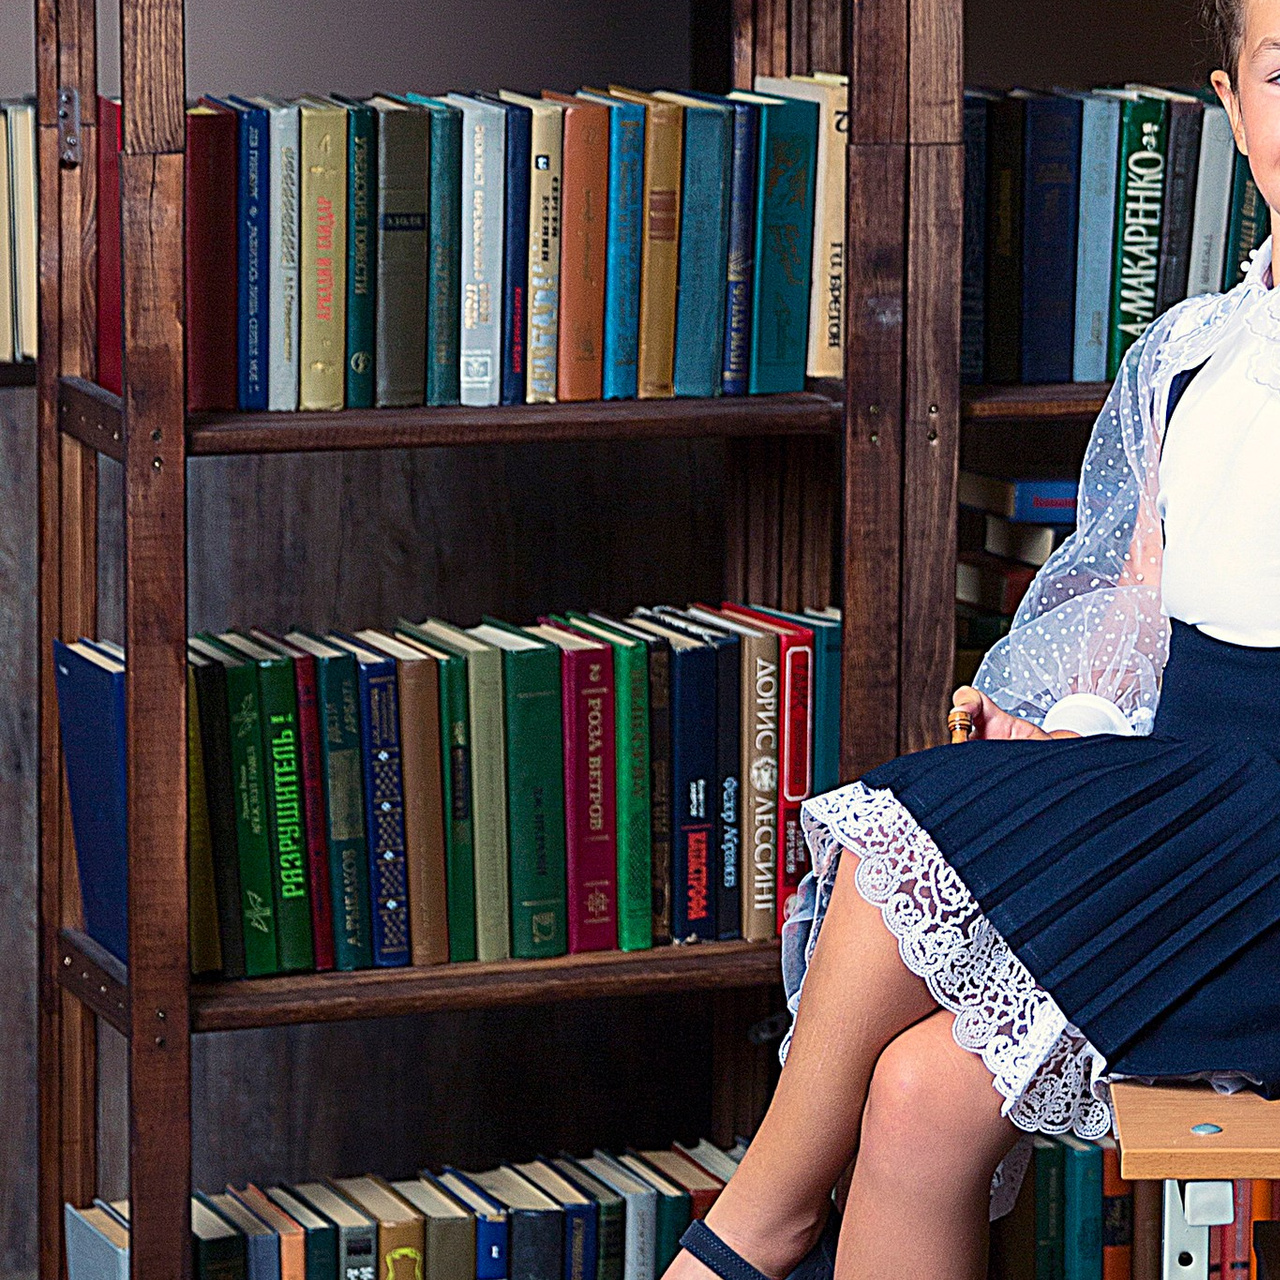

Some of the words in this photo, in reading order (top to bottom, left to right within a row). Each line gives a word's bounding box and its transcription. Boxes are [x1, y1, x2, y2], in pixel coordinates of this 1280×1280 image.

[1120, 150, 1165, 318] МАКАРЕНКО
[587, 698, 605, 753] РОЗА
[754, 657, 778, 750] ДОРИС
[588, 757, 605, 831] ВЕТРОВ
[720, 776, 739, 823] Федор
[720, 825, 739, 888] Абрамов
[753, 796, 776, 913] ЛЕССИНГ
